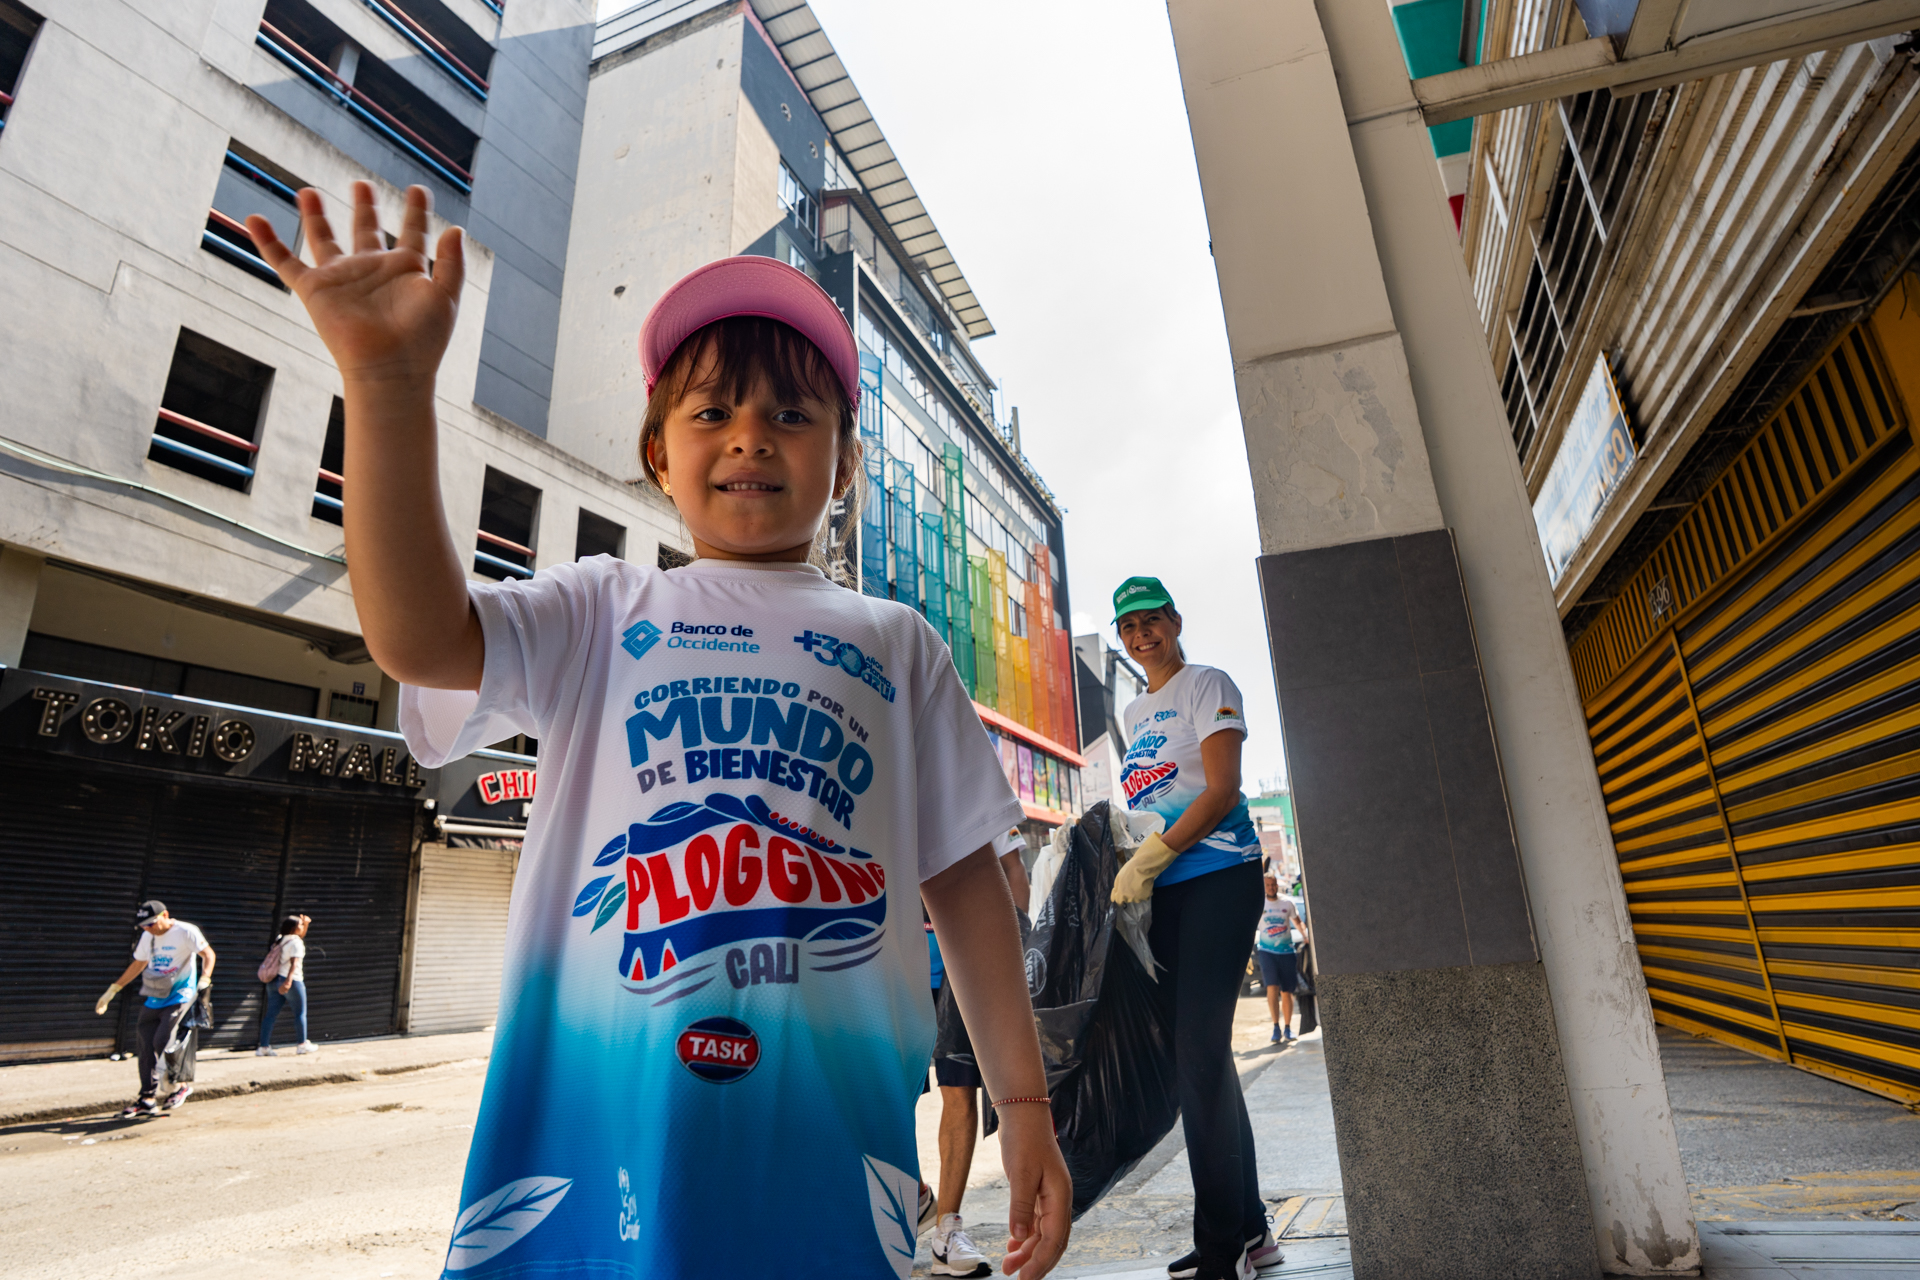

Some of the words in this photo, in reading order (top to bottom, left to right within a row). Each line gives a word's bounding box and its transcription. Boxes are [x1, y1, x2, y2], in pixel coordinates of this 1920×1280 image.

[667, 635, 760, 654] Occidente
[670, 621, 727, 636] Banco
[731, 622, 754, 638] de
[793, 630, 866, 677] +30
[634, 676, 801, 710] CORRIENDO
[807, 689, 844, 719] POR
[848, 716, 869, 743] UN
[861, 672, 896, 704] azul
[32, 687, 257, 763] TOKIO
[289, 731, 427, 789] MALL
[625, 696, 874, 795] MUNDO
[636, 760, 676, 794] DE
[684, 747, 855, 831] BIENESTAR
[626, 823, 886, 931] PLOGGING
[725, 942, 800, 989] CALI
[689, 1036, 749, 1063] TASK
